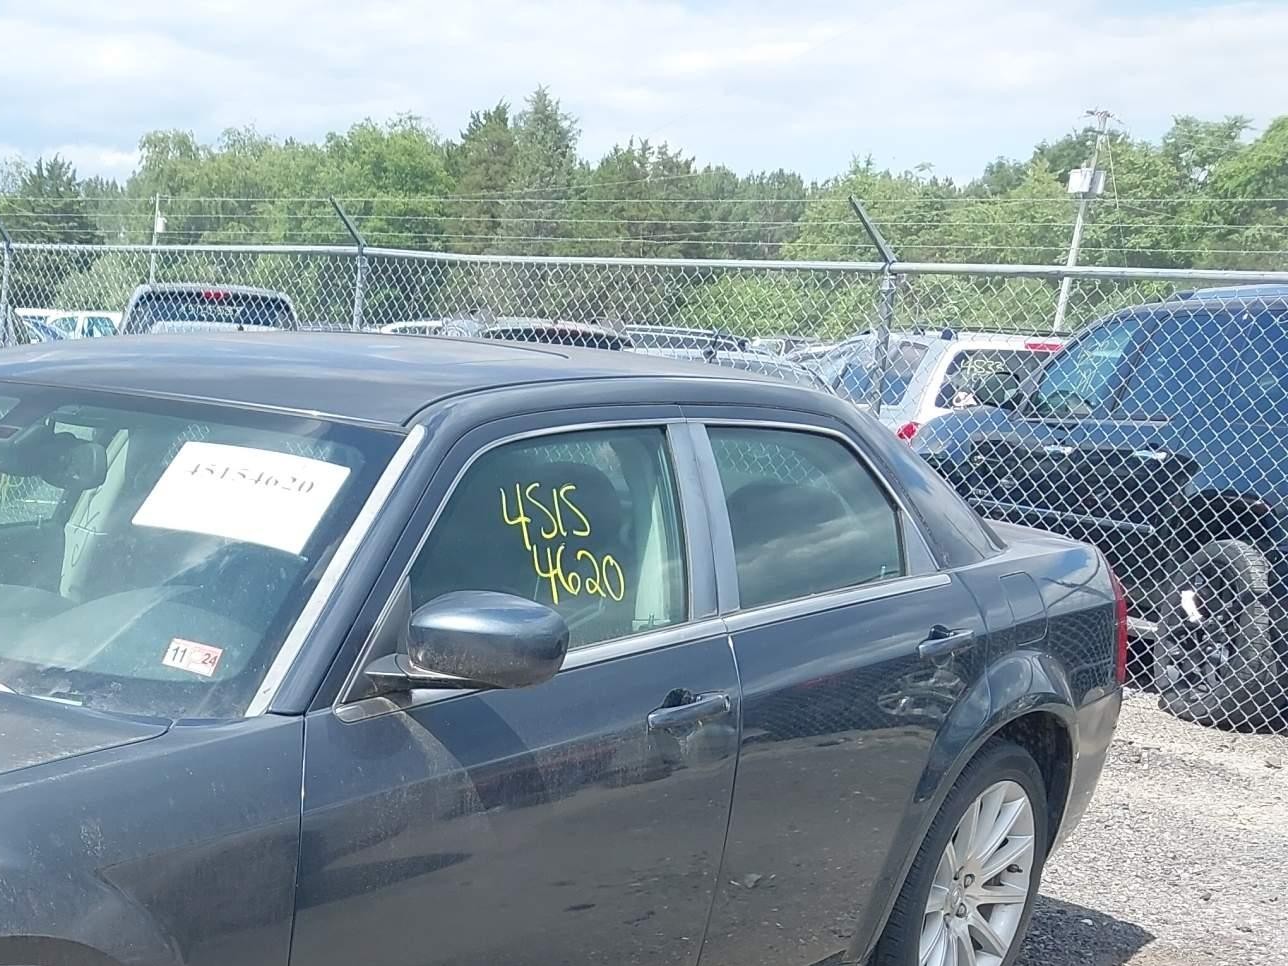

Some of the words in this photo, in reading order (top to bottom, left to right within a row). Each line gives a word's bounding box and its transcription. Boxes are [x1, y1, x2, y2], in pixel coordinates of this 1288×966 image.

[499, 482, 591, 551] 4515
[533, 542, 625, 606] 4620
[172, 646, 188, 663] 11
[202, 652, 218, 667] 24
